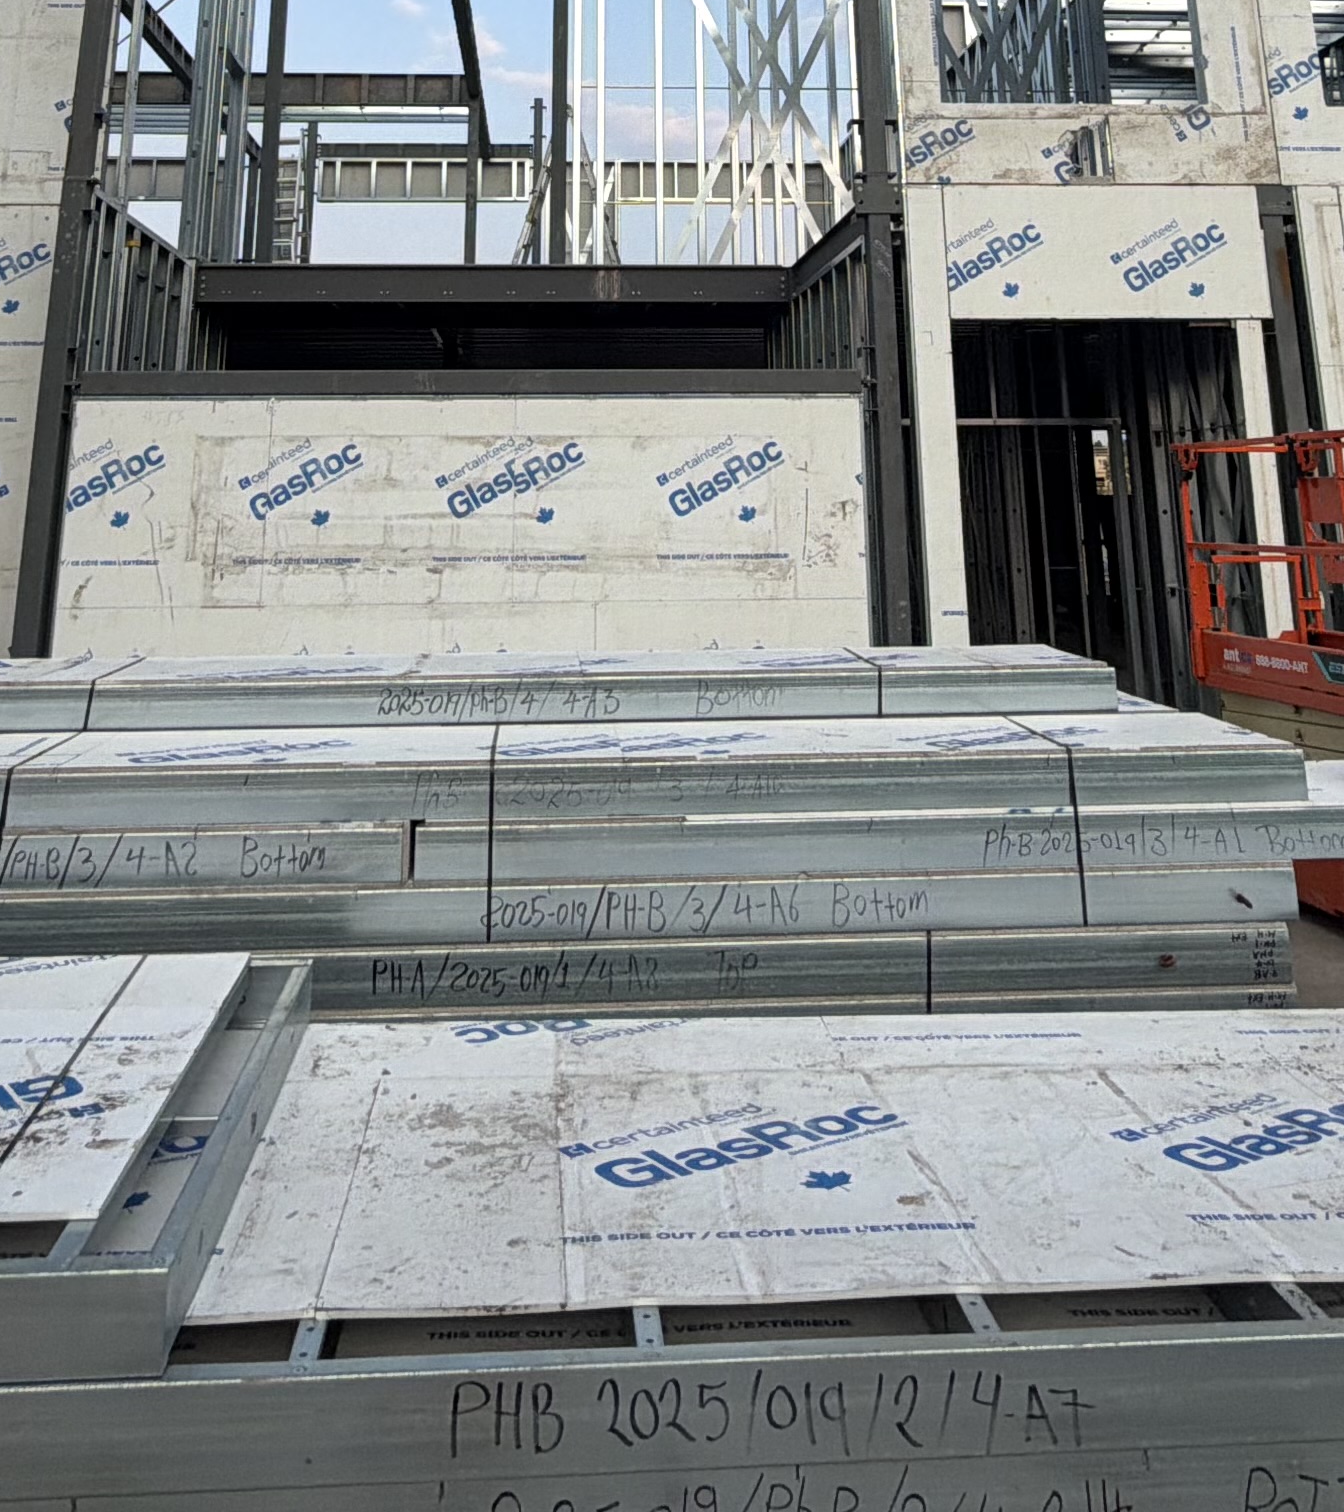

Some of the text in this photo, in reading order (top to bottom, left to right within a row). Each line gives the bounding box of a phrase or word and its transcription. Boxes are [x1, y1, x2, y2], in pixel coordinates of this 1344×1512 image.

[904, 119, 974, 170] asRoc
[1121, 217, 1180, 263] certainteed
[1124, 223, 1226, 293] GlasRoc
[65, 444, 165, 515] lasRoc
[668, 435, 734, 482] certainteed
[668, 441, 784, 519] GlasRoc
[592, 1102, 763, 1151] certainteed
[594, 1104, 899, 1188] GlasRoc
[559, 1234, 603, 1245] THIS
[607, 1232, 652, 1243] SIDE
[656, 1230, 696, 1241] OUT
[715, 1229, 741, 1240] CE
[744, 1225, 796, 1239] CÔTÉ
[800, 1225, 852, 1236] VERS
[1190, 1212, 1232, 1223] THIS
[1235, 1211, 1279, 1222] SIDE
[1282, 1210, 1318, 1221] OUT
[524, 1326, 568, 1339] OUT
[673, 1321, 723, 1334] VERS
[1068, 1307, 1111, 1319] THIS
[1158, 1305, 1199, 1317] OUT
[450, 1378, 566, 1458] PHB
